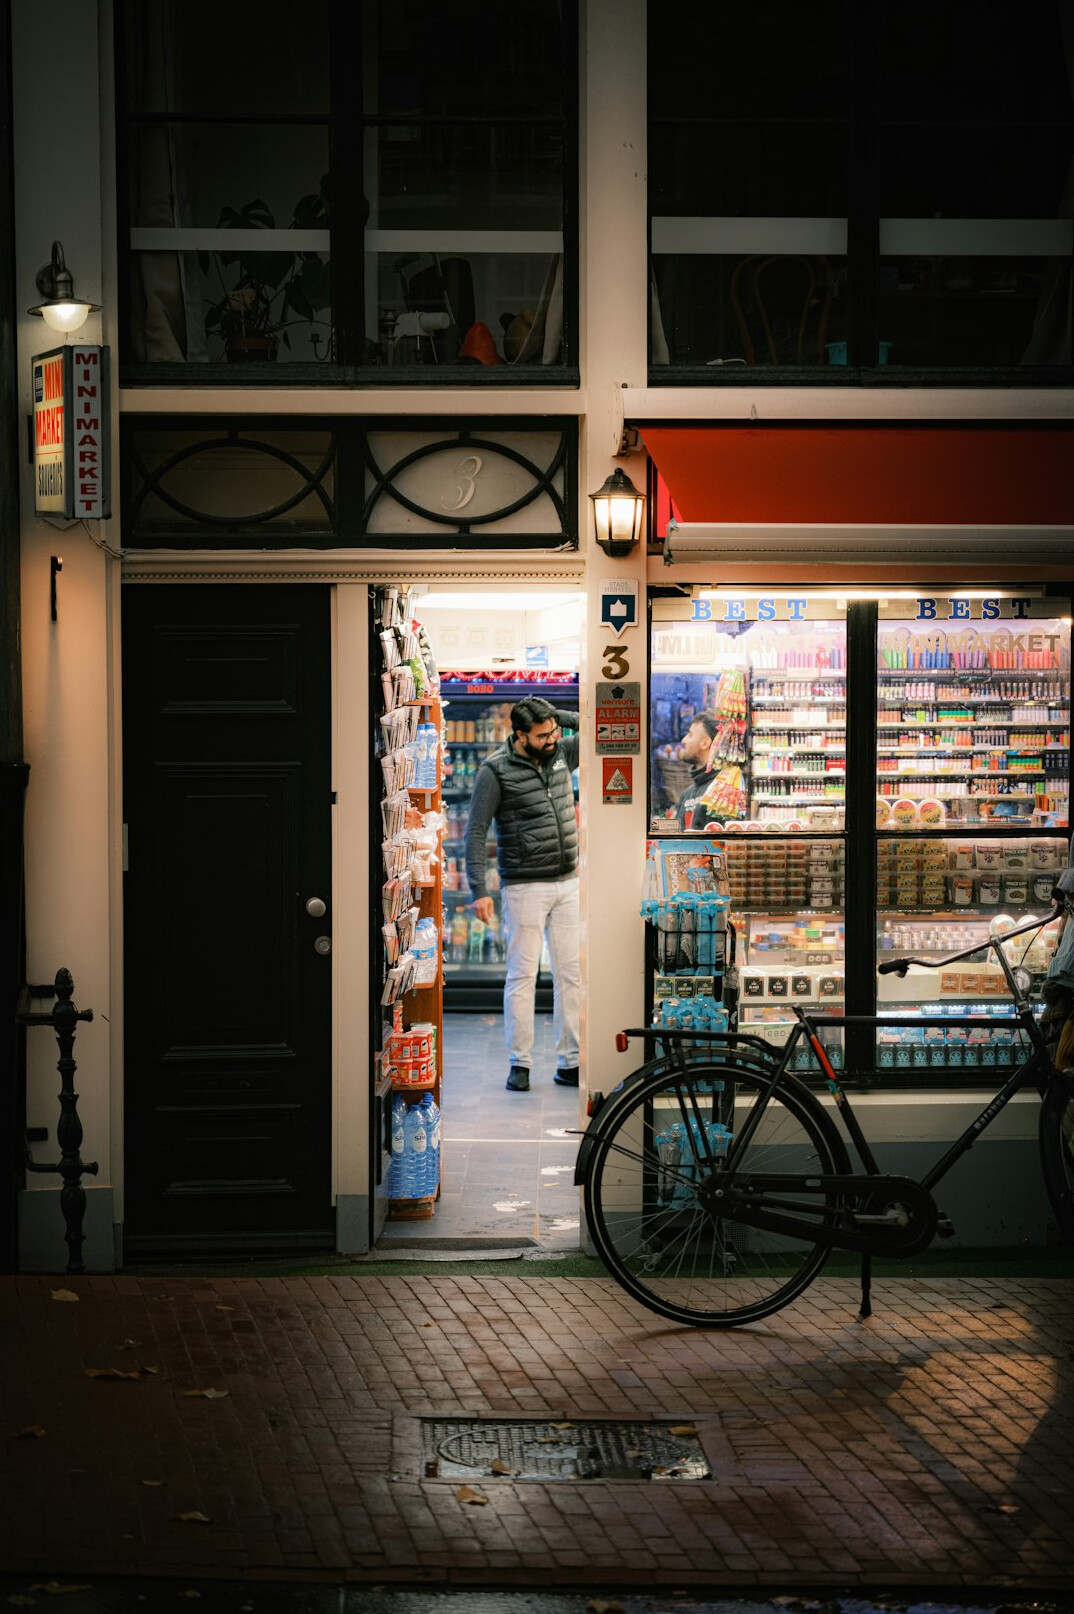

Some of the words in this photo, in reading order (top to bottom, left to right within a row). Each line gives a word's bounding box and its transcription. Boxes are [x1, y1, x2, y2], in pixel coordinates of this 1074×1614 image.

[35, 406, 64, 446] MARKET
[75, 353, 99, 511] MINIMARKET
[440, 455, 483, 511] 3
[691, 599, 807, 621] BEST
[916, 599, 1031, 620] BEST
[601, 645, 630, 680] 3
[598, 709, 639, 718] ALARM
